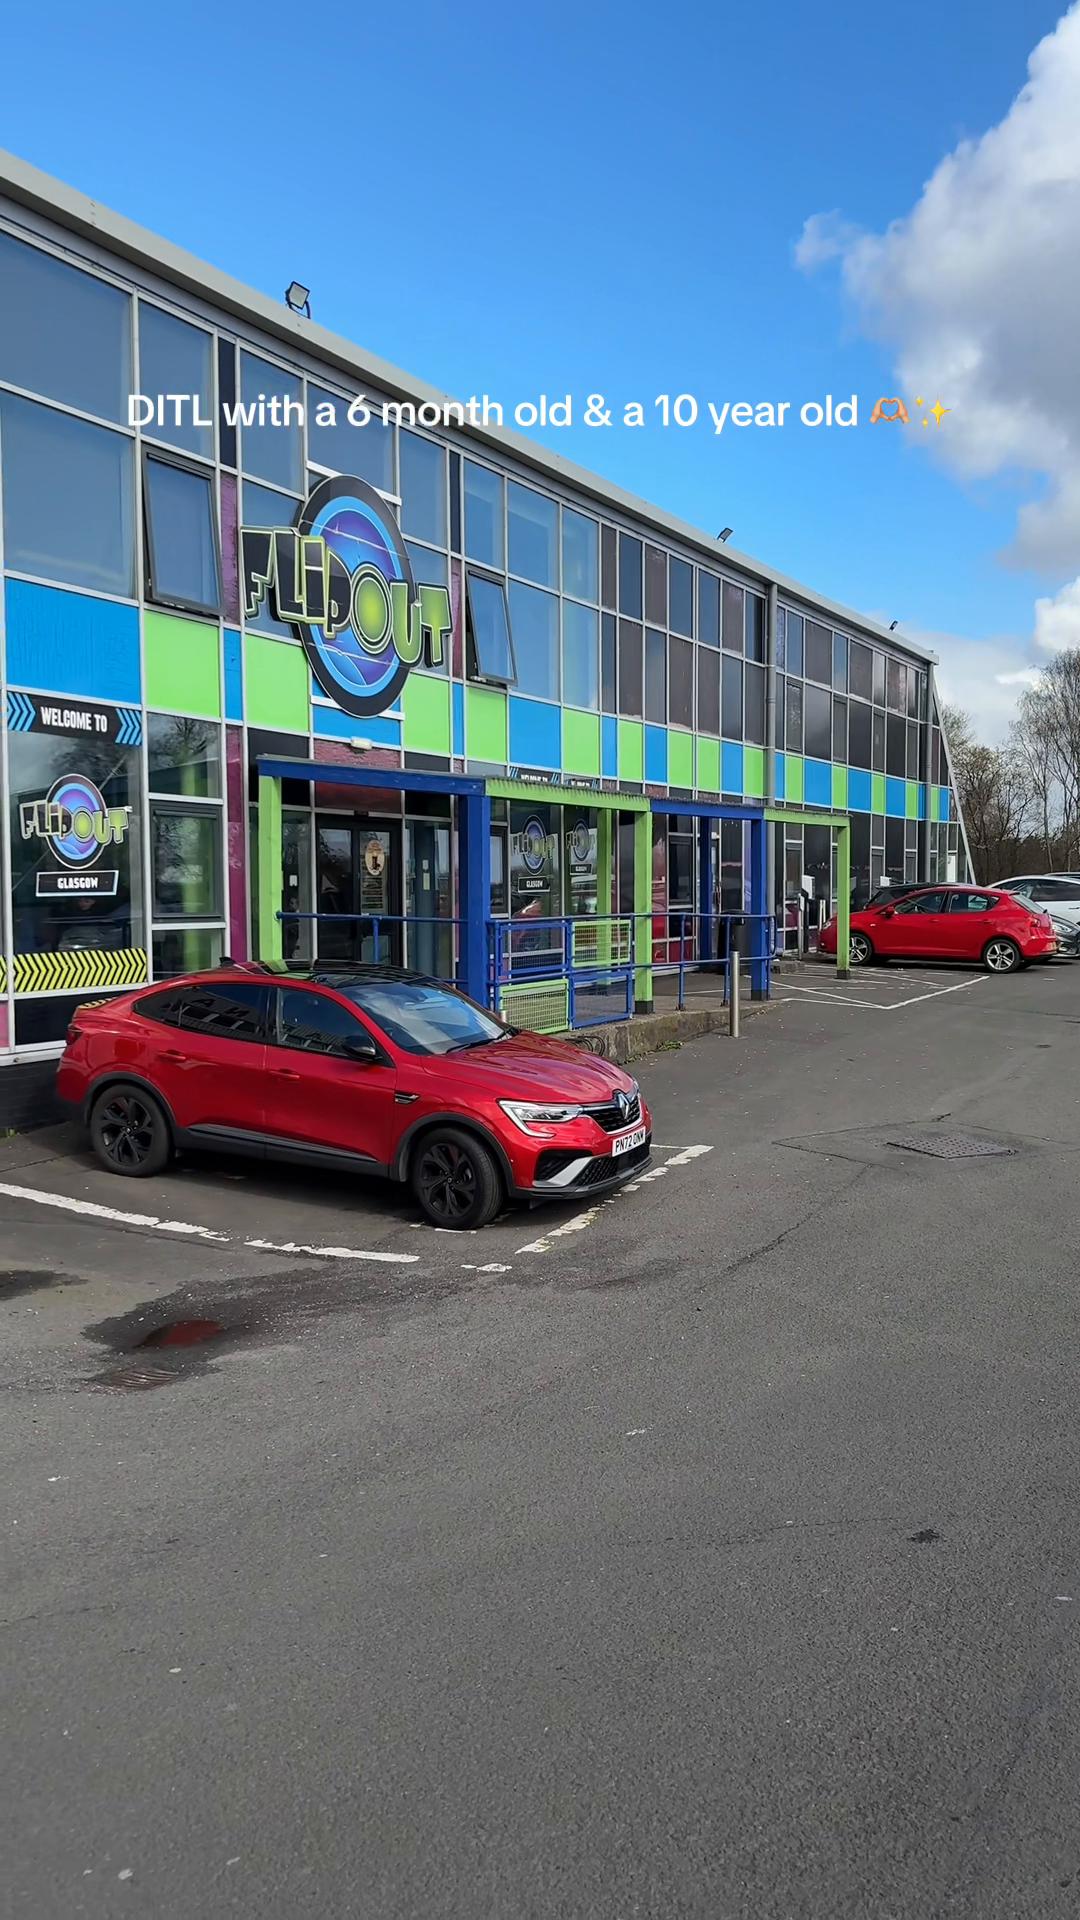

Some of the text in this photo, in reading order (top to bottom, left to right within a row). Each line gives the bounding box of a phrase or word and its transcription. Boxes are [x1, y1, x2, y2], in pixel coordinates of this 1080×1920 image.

[41, 706, 108, 733] WELCOME TO
[57, 877, 98, 889] GLASGOW
[615, 1134, 633, 1153] PN72
